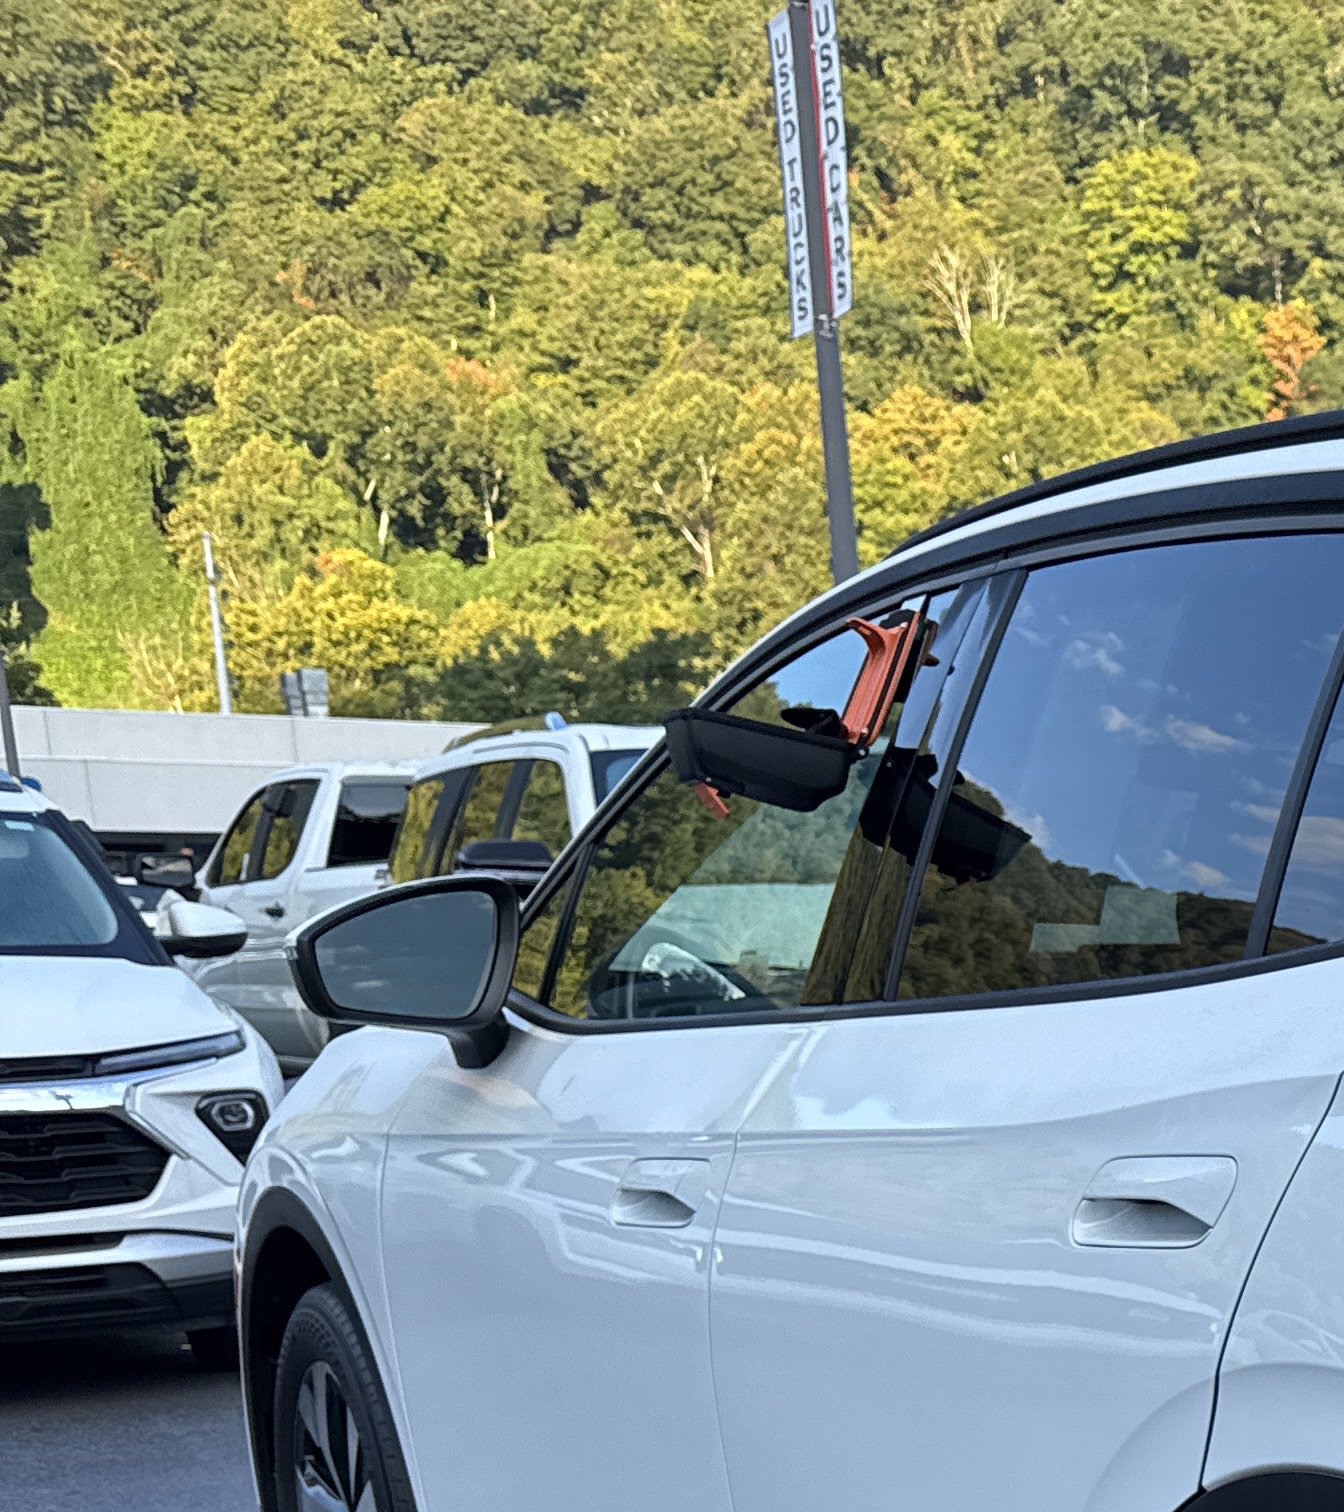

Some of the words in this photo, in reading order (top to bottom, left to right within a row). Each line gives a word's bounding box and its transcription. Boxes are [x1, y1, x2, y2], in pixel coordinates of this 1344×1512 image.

[774, 32, 796, 144] USED
[787, 157, 809, 321] TRUCKS
[816, 4, 840, 147] USED
[829, 163, 847, 300] CARS
